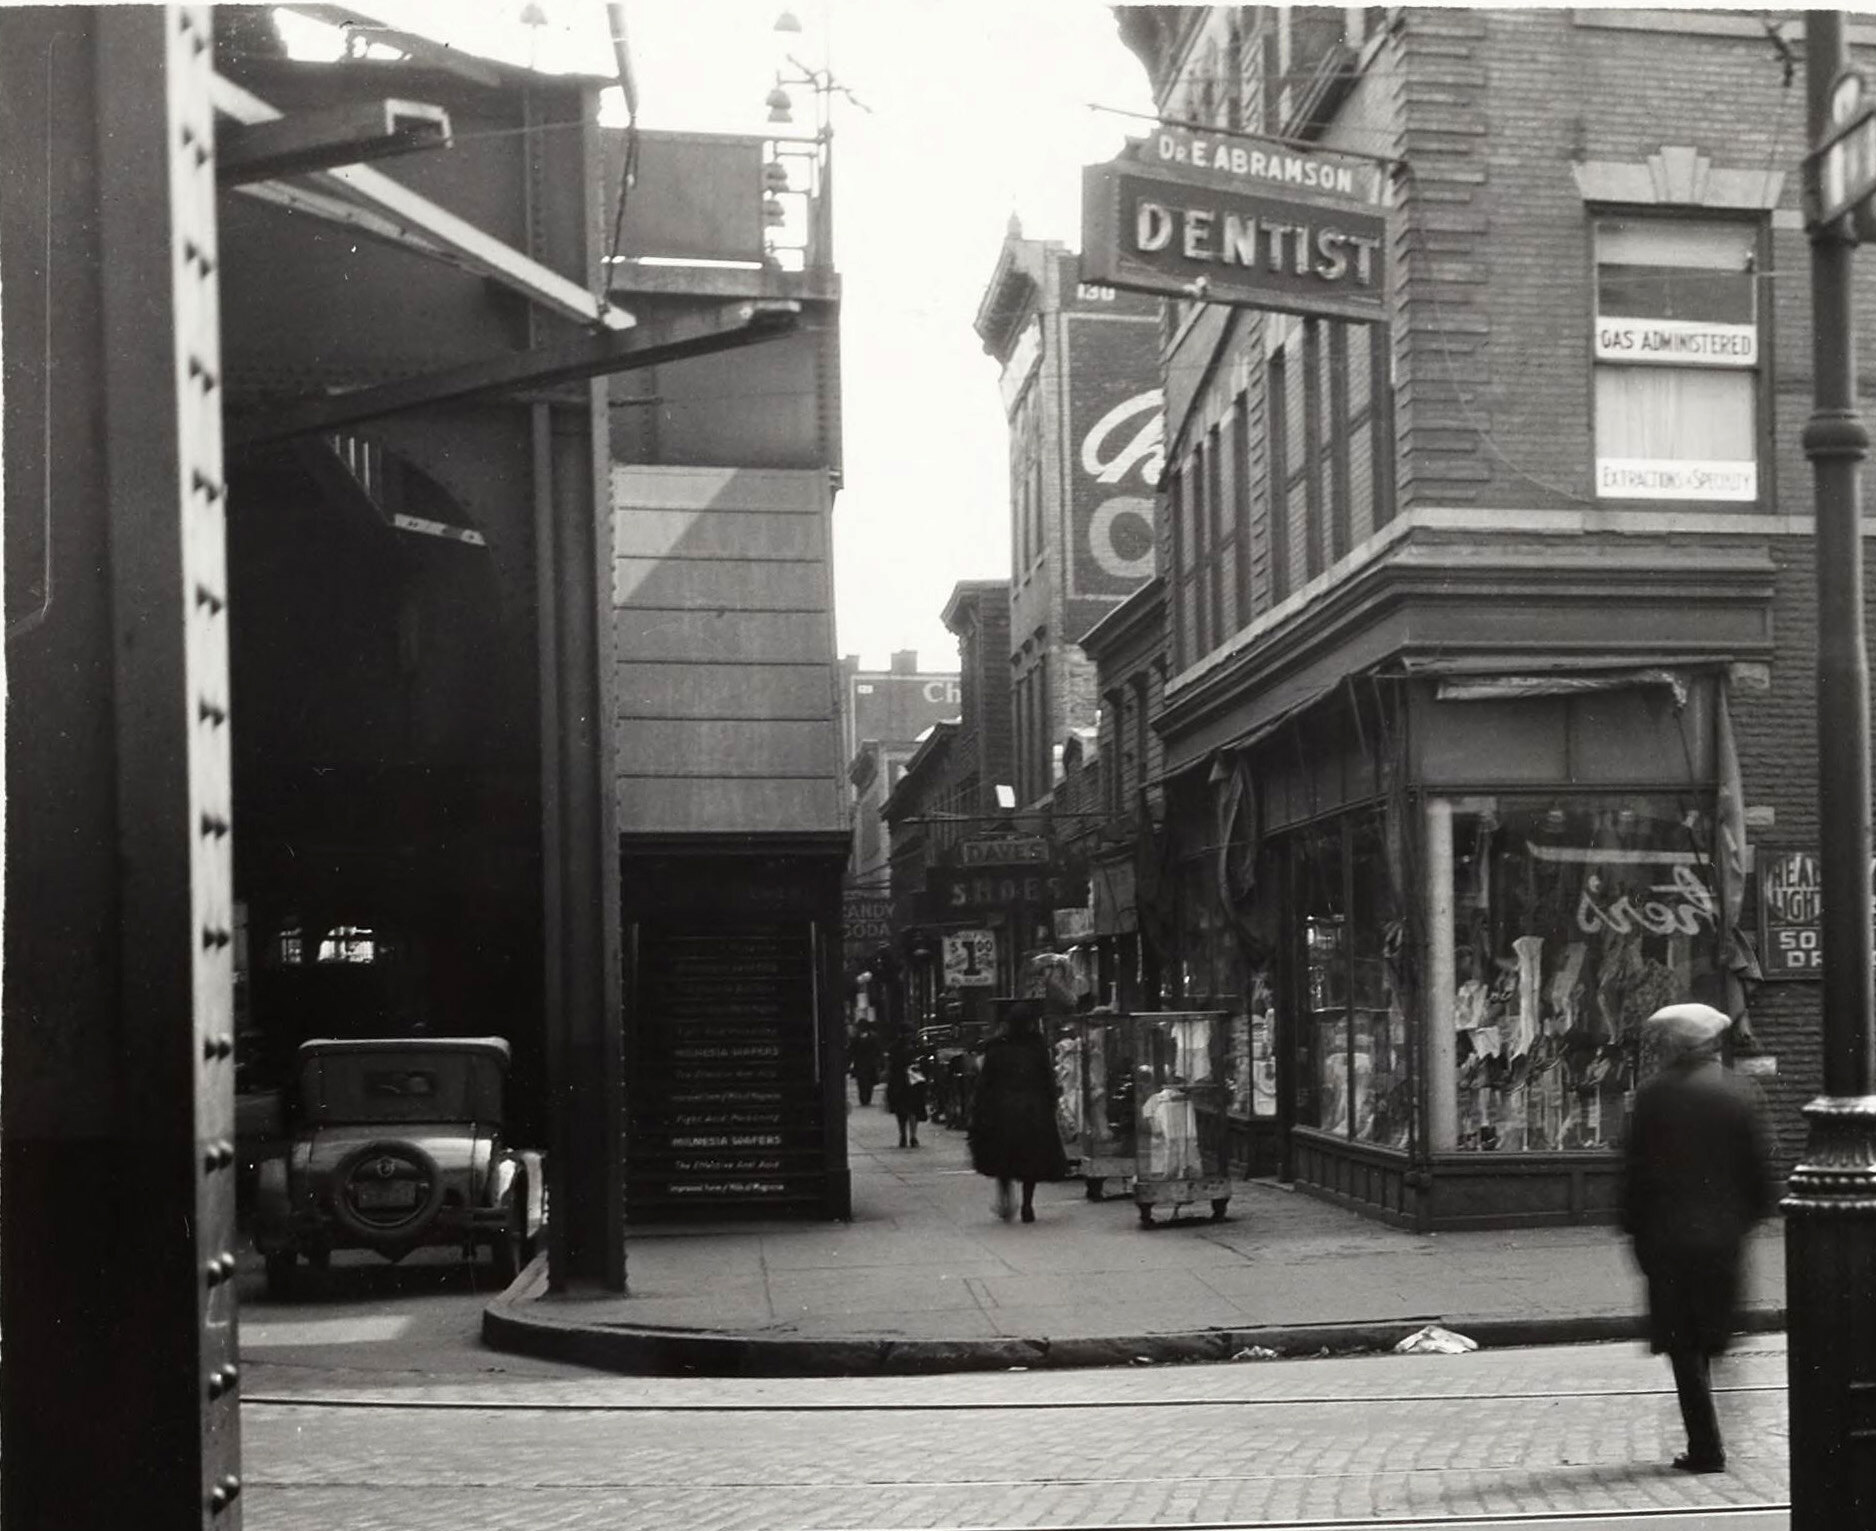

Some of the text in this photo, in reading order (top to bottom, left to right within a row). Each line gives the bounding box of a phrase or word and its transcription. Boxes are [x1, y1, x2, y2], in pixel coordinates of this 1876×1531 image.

[1214, 145, 1352, 194] ABRAMSON
[1136, 202, 1381, 286] DENTIST
[1601, 329, 1634, 350] GAS
[951, 876, 1063, 906] SHOES
